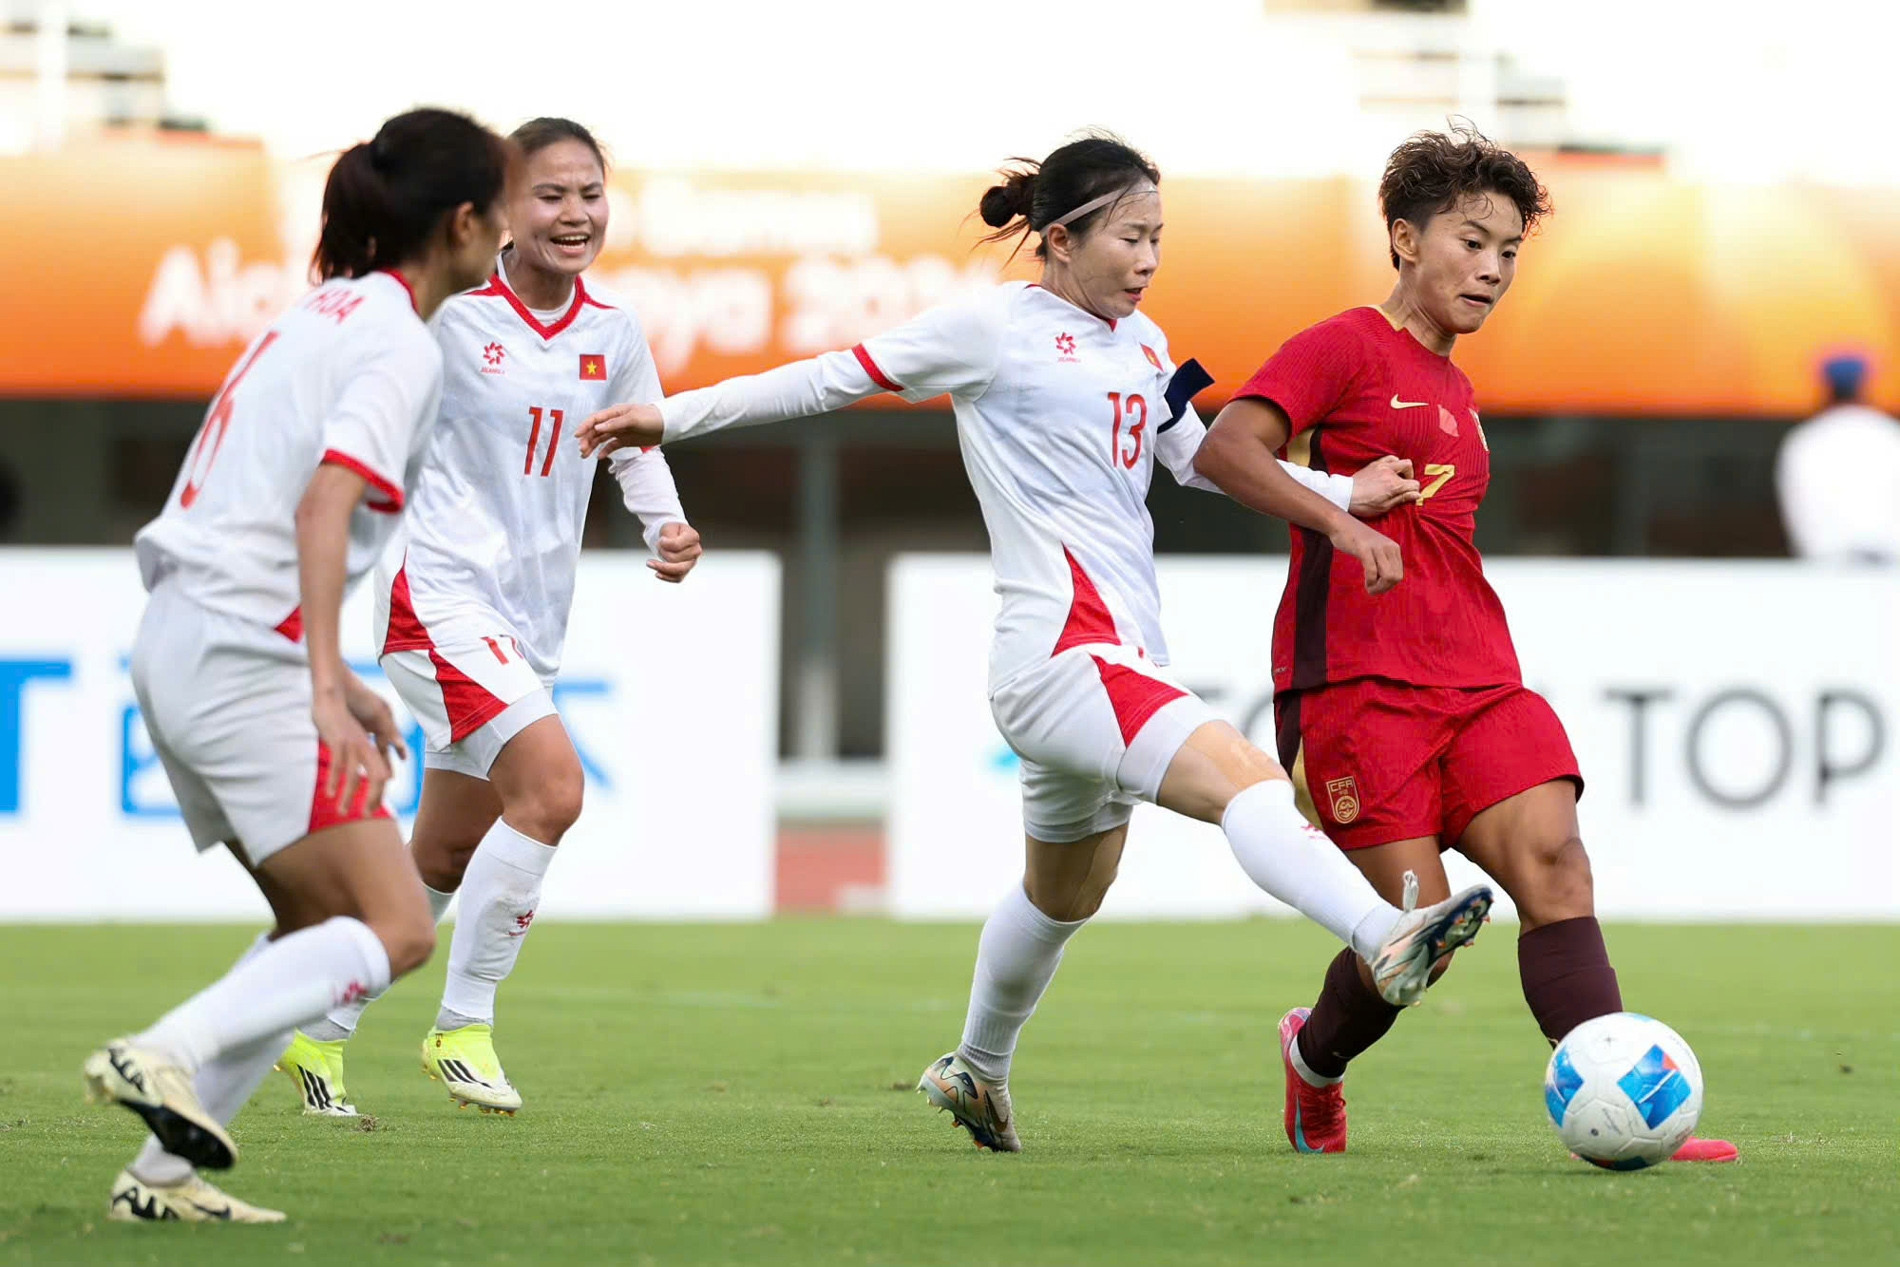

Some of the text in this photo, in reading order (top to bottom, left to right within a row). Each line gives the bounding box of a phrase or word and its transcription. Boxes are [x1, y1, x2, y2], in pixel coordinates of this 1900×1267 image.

[524, 406, 564, 477] 11
[1107, 391, 1147, 470] 13
[1601, 685, 1885, 810] TOP
